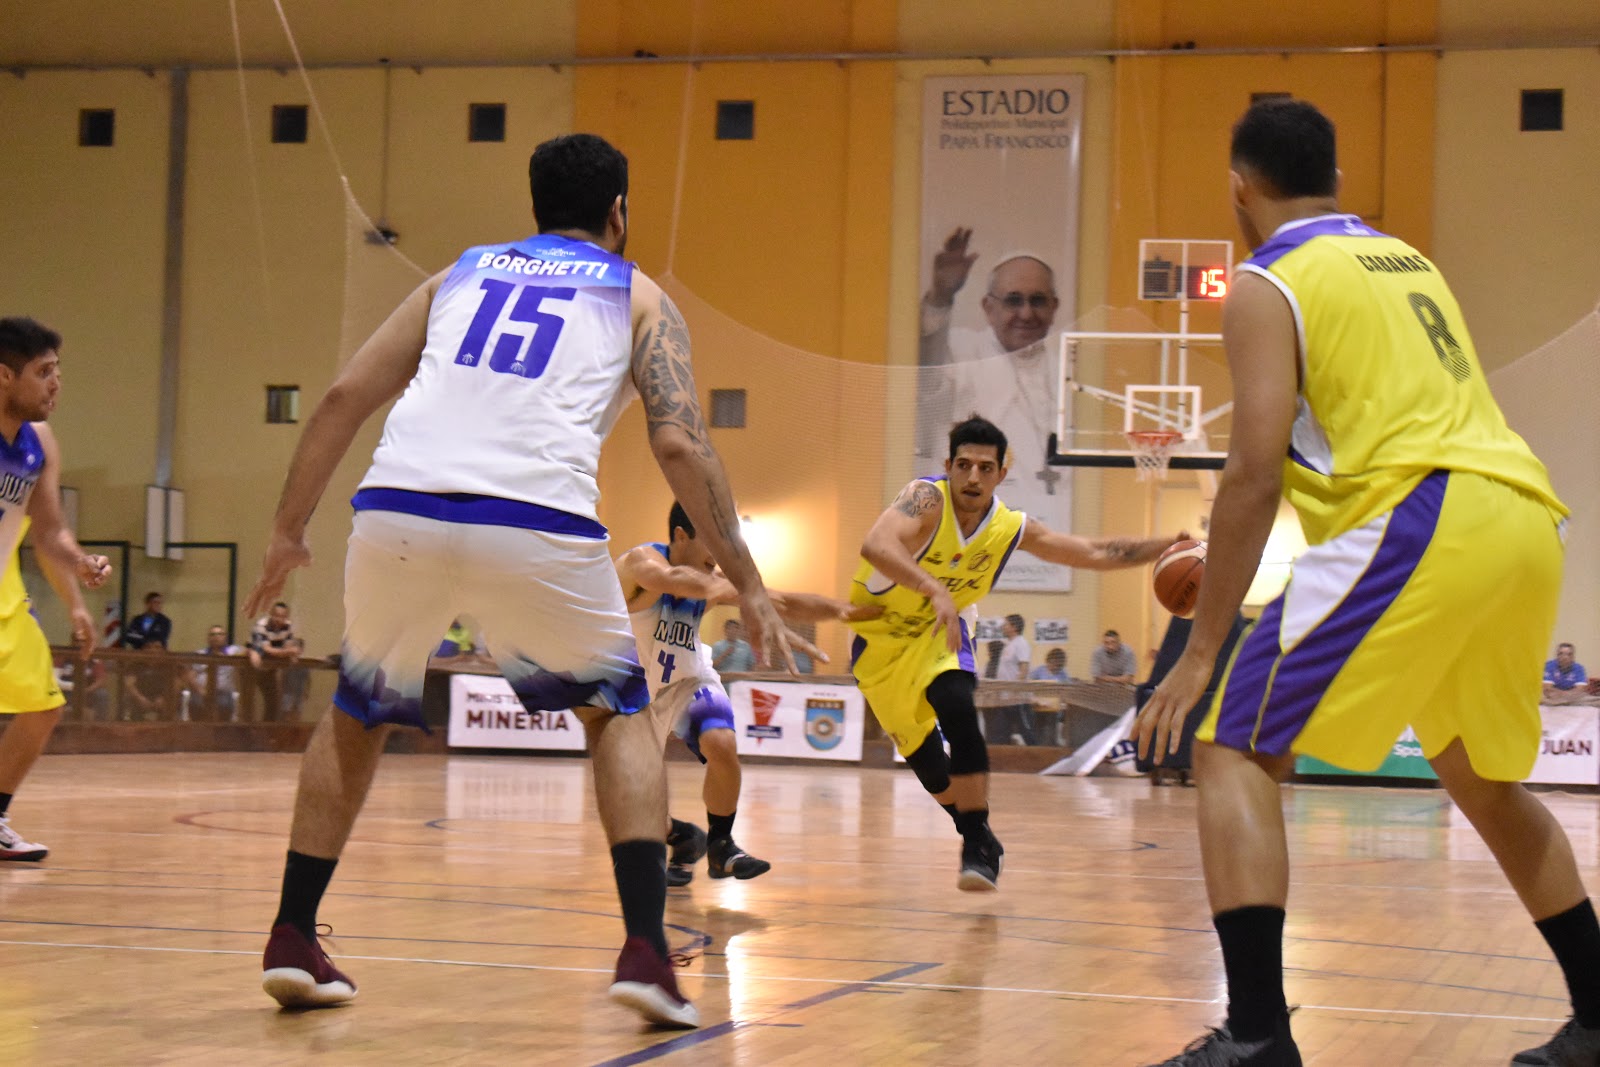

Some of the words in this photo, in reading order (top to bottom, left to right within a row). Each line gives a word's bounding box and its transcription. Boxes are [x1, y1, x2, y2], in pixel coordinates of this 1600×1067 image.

[943, 88, 1070, 115] ESTADIO
[940, 133, 979, 149] PAPA
[984, 133, 1070, 149] FRANCISCO
[476, 253, 609, 280] BORGHETTI
[1200, 269, 1227, 298] 15
[454, 278, 578, 380] 15
[1407, 291, 1471, 384] 8
[657, 649, 676, 684] 4
[466, 710, 569, 731] MINERIA
[1542, 739, 1593, 756] JUAN
